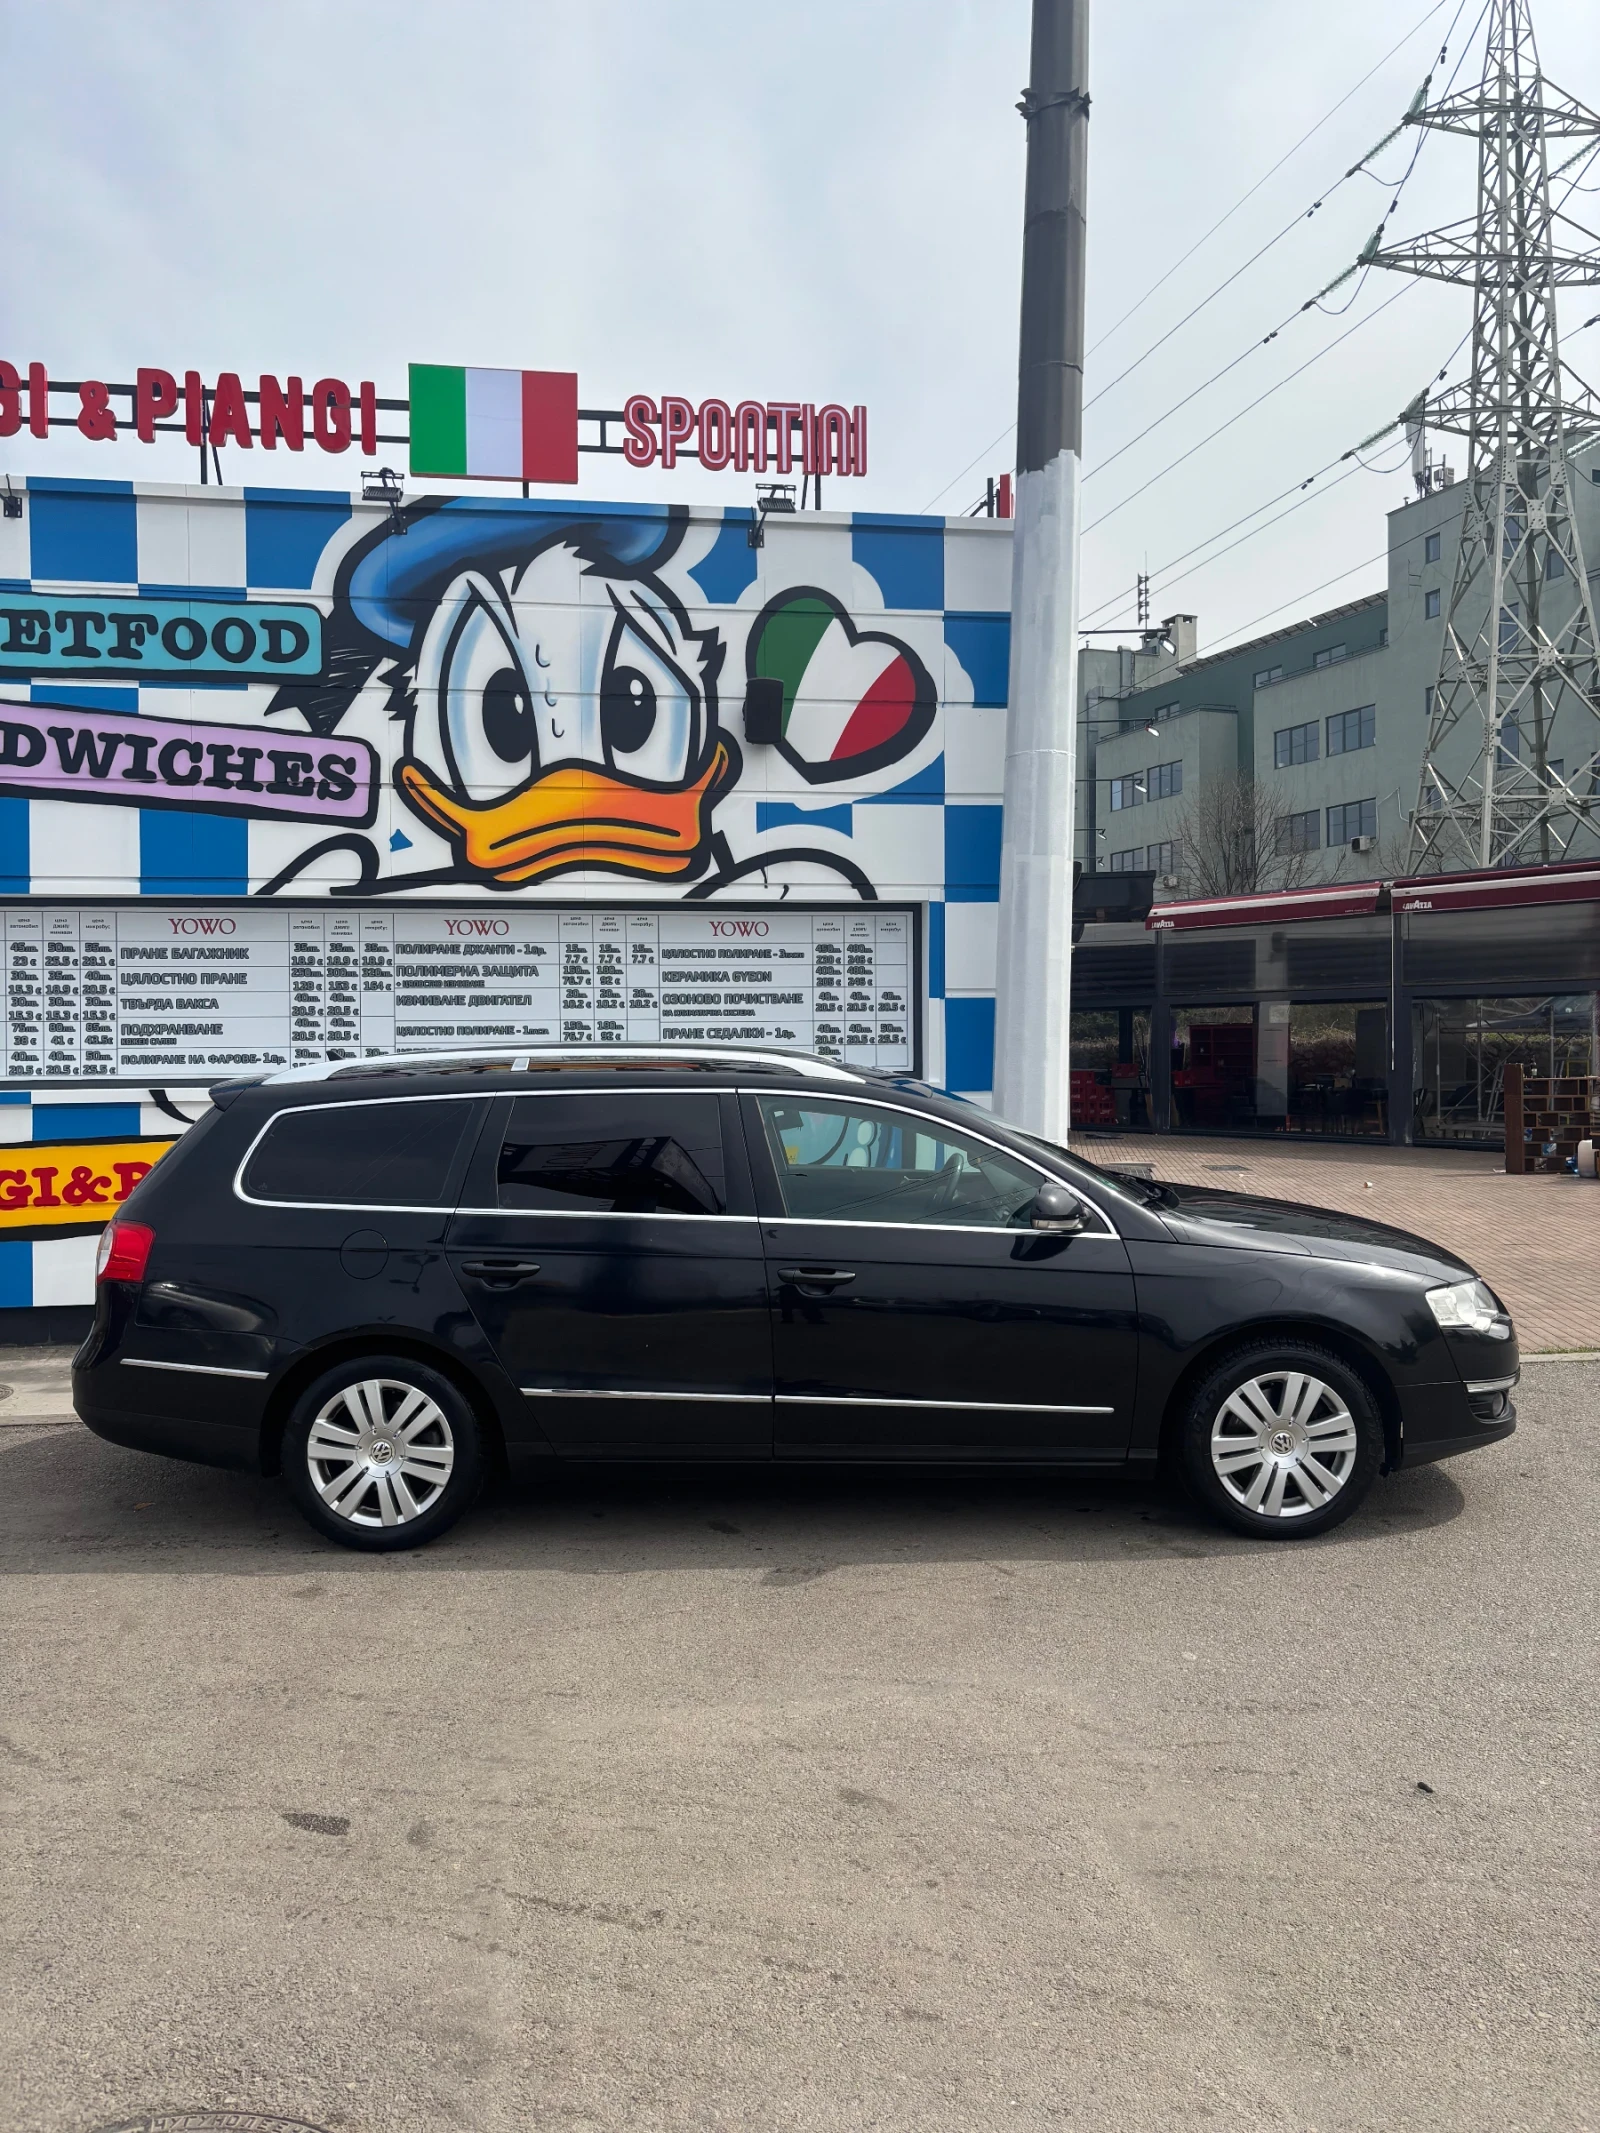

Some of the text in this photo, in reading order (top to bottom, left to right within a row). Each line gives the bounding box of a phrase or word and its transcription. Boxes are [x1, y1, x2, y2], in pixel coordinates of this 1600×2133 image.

[77, 380, 117, 441] &
[137, 368, 376, 456] PIANGI
[623, 394, 867, 477] SPONTINI
[0, 609, 310, 663] ETFOOD
[0, 720, 357, 801] DWICHES
[168, 918, 237, 935] YOWO
[444, 919, 510, 936] YOWO
[709, 921, 769, 937] YOWO
[120, 947, 250, 960] ПРАНЕ БАГАЖНИК
[395, 944, 461, 955] ПОЛИРАНЕ
[463, 944, 516, 956] ДЖАНТИ
[662, 949, 716, 959] ЦЯЛОСТНО
[718, 949, 772, 958] ПОЛИРАНЕ
[12, 956, 28, 967] 23
[44, 956, 71, 967] 25.5
[82, 956, 107, 967] 28.1
[396, 965, 539, 978] ПОЛИМЕРНА ЗАЩИТА
[662, 971, 731, 982] КЕРАМИКА
[120, 972, 248, 986] ЦЯЛОСТНО ПРАНЕ
[8, 984, 34, 995] 15.3
[45, 984, 71, 995] 18.9
[82, 984, 107, 995] 20.5
[120, 998, 220, 1011] ТВЪРДА ВАКСА
[396, 995, 533, 1007] ИЗМИВАНЕ ДВИГАТЕЛ
[662, 993, 804, 1005] ОЗОНОВО ПОЧИСТВАНЕ
[8, 1010, 34, 1021] 15.3
[45, 1010, 71, 1021] 15.3
[82, 1010, 108, 1021] 15.3
[120, 1023, 224, 1037] ПОДХРАНВАНЕ
[396, 1026, 455, 1037] ЦЯЛОСТНО
[456, 1026, 515, 1036] ПОЛИРАНЕ
[663, 1027, 704, 1039] ПРАНЕ
[706, 1027, 765, 1040] СЕДАЛКИ
[13, 1035, 29, 1045] 38
[50, 1035, 65, 1045] 41
[149, 1038, 177, 1046] САЛОН
[121, 1054, 186, 1065] ПОЛИРАНЕ
[187, 1054, 206, 1064] НА
[8, 1065, 34, 1076] 20.5
[45, 1064, 71, 1075] 20.5
[82, 1064, 108, 1075] 25.5
